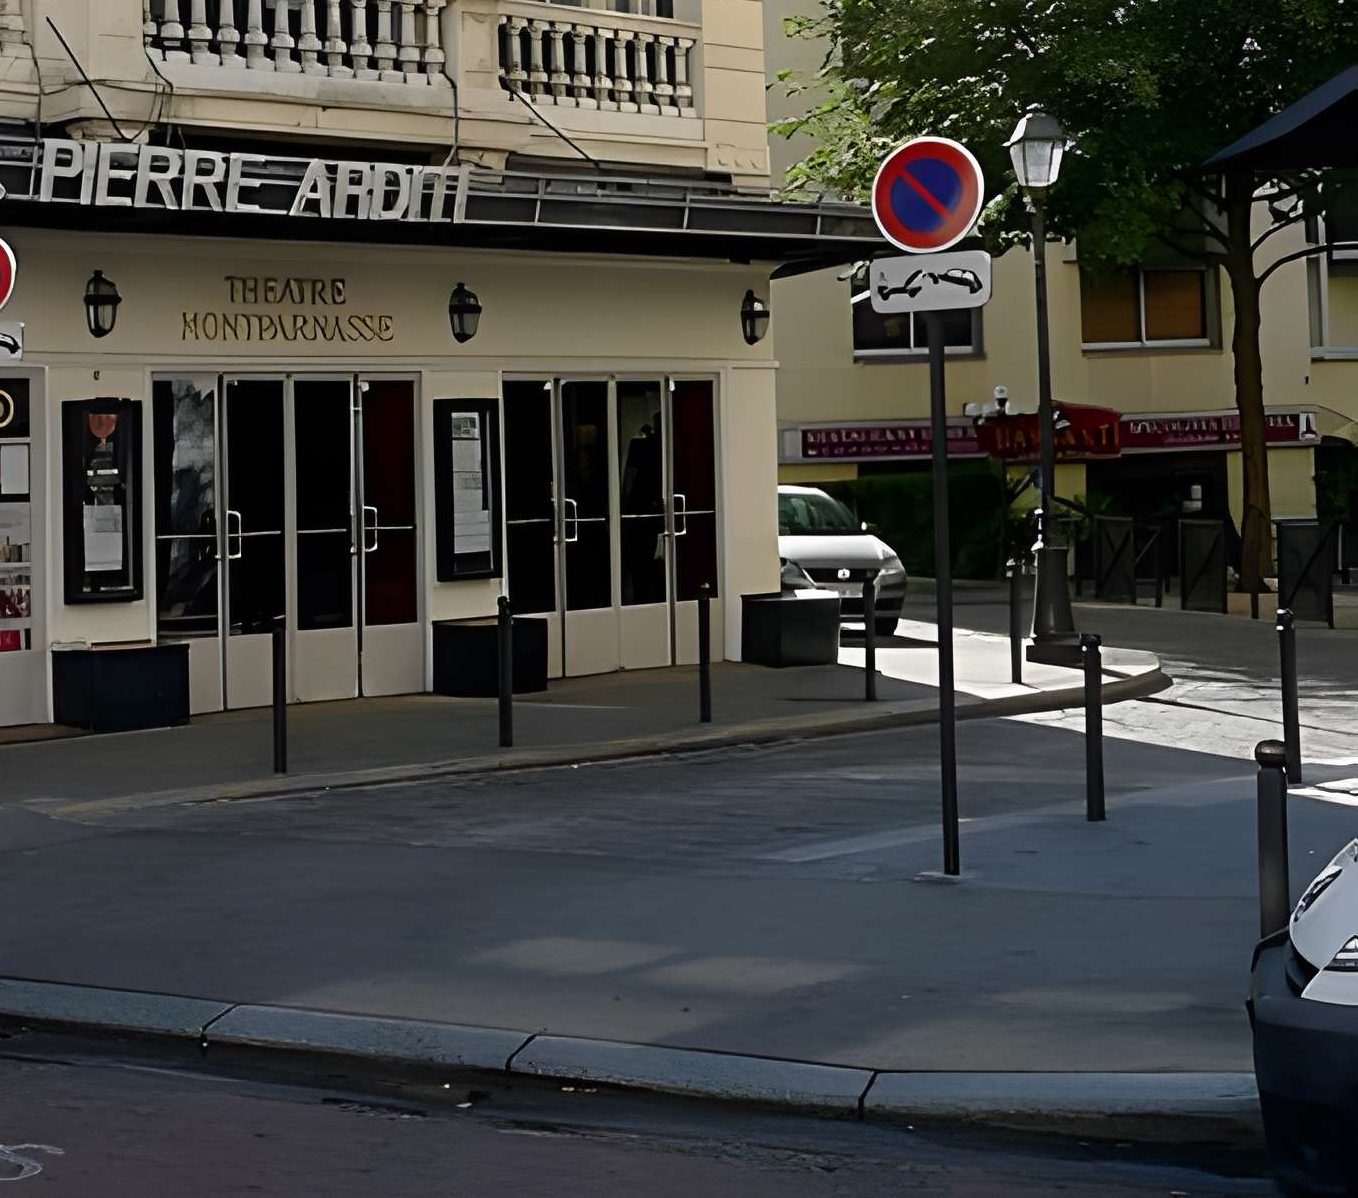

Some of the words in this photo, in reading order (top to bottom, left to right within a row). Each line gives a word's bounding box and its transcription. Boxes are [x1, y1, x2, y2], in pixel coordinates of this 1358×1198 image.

[40, 138, 265, 212] PIERRE
[224, 276, 346, 305] THEATRE
[182, 312, 394, 342] MONTPARNASSE
